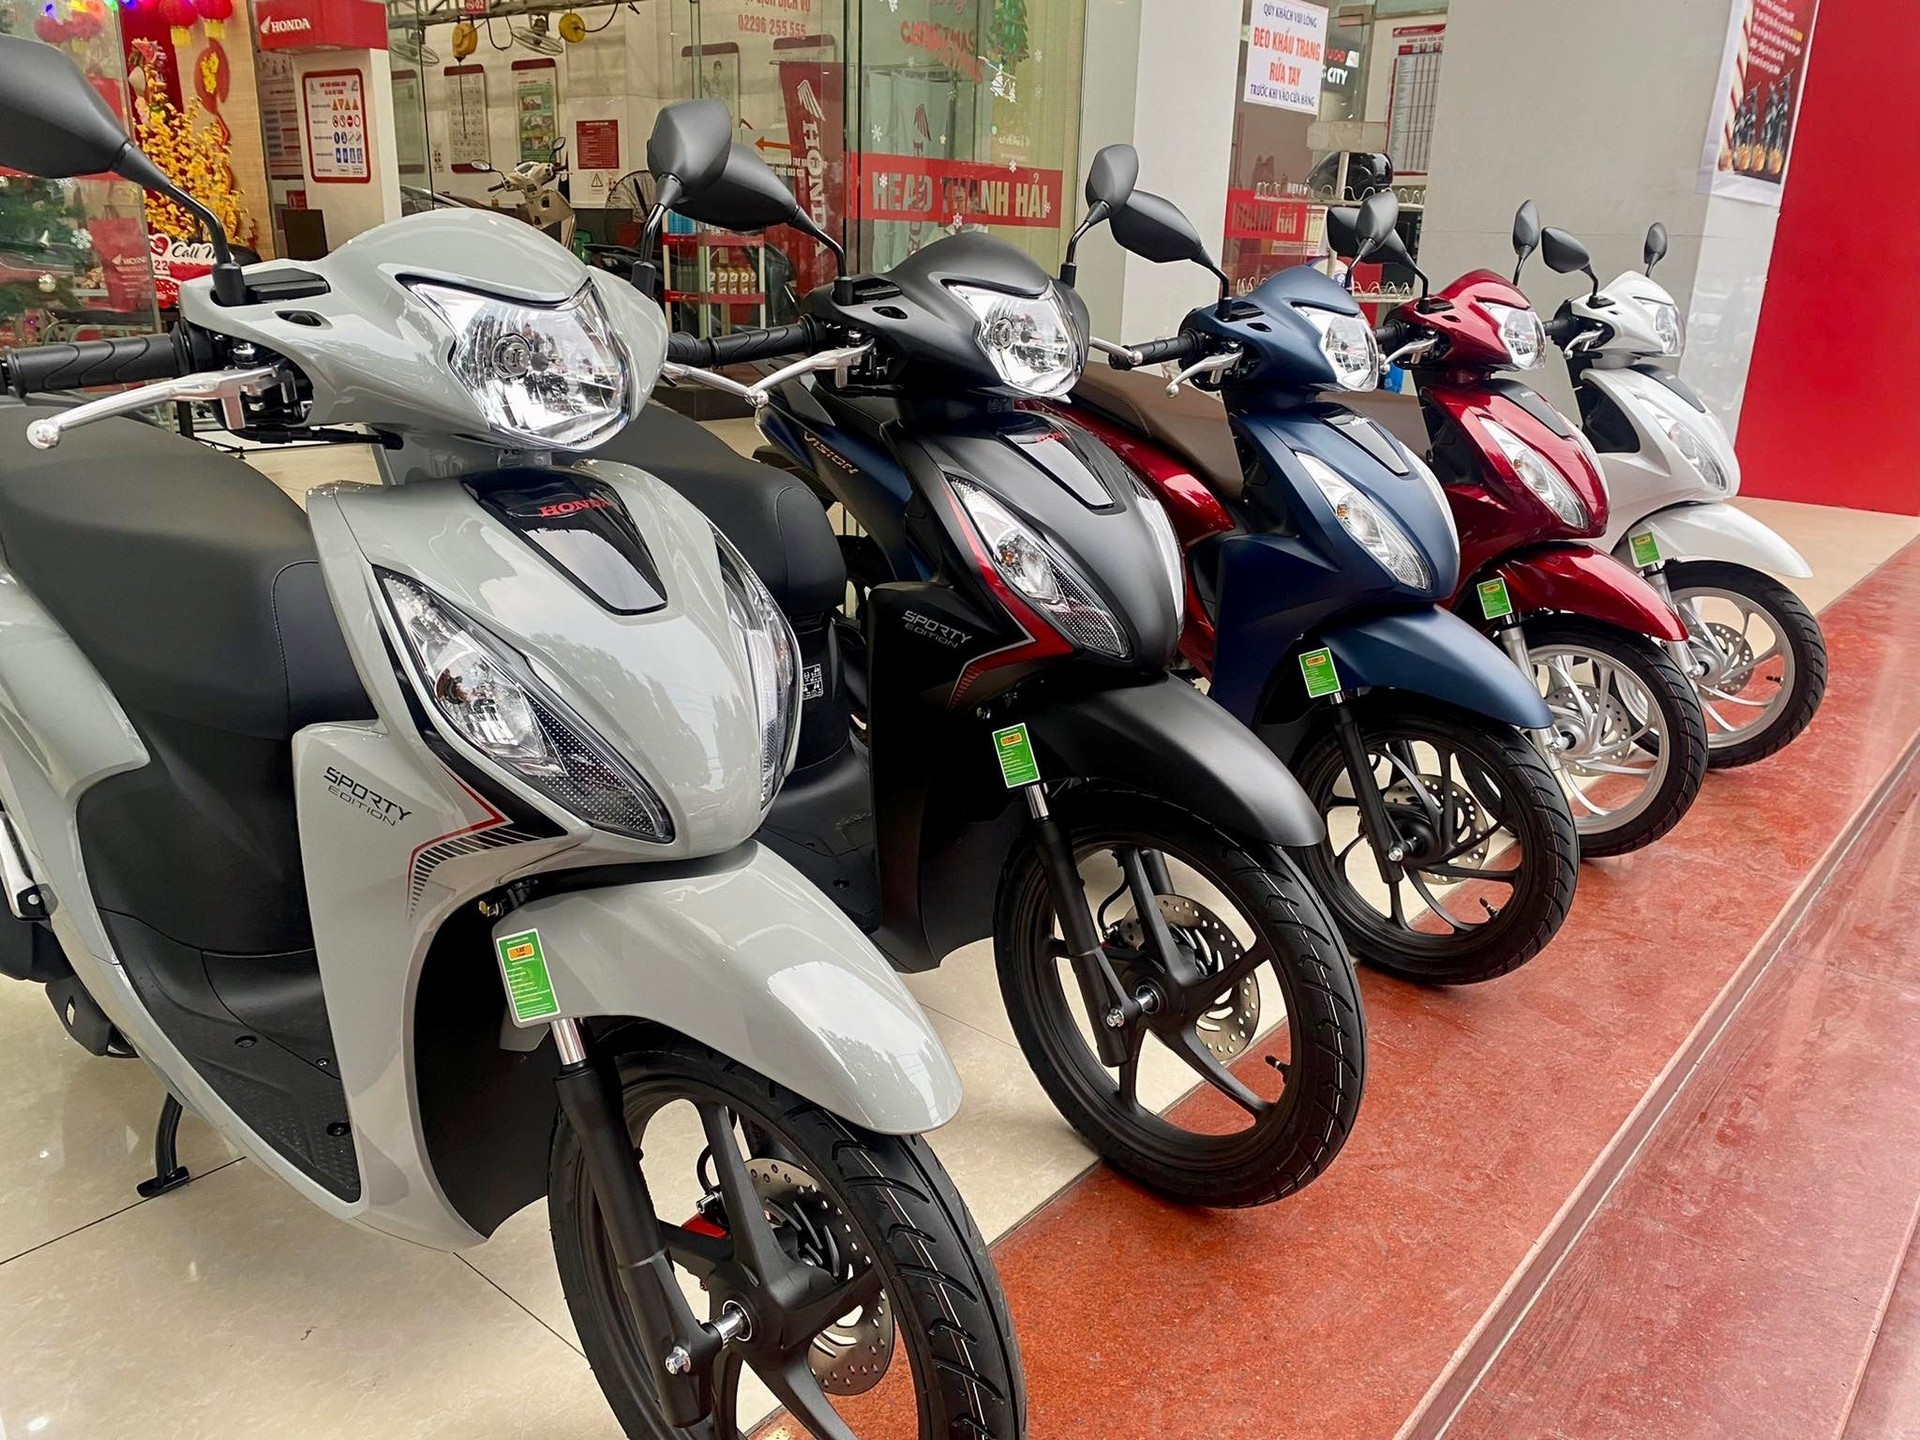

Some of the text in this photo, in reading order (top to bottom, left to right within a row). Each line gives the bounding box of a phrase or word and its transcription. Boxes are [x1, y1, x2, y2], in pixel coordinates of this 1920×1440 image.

[271, 18, 311, 33] HONDA
[738, 14, 806, 40] 02296 255 555
[1254, 27, 1271, 48] ĐEO
[1296, 38, 1321, 61] TRANG
[1288, 65, 1302, 86] TAY
[1327, 66, 1348, 85] CITY
[872, 171, 1049, 219] HEAD THANH HẢI
[172, 243, 200, 259] Call
[902, 610, 972, 643] SPORTY
[905, 622, 958, 648] EDITION
[323, 766, 412, 820] SPORTY
[328, 785, 396, 826] EDITION
